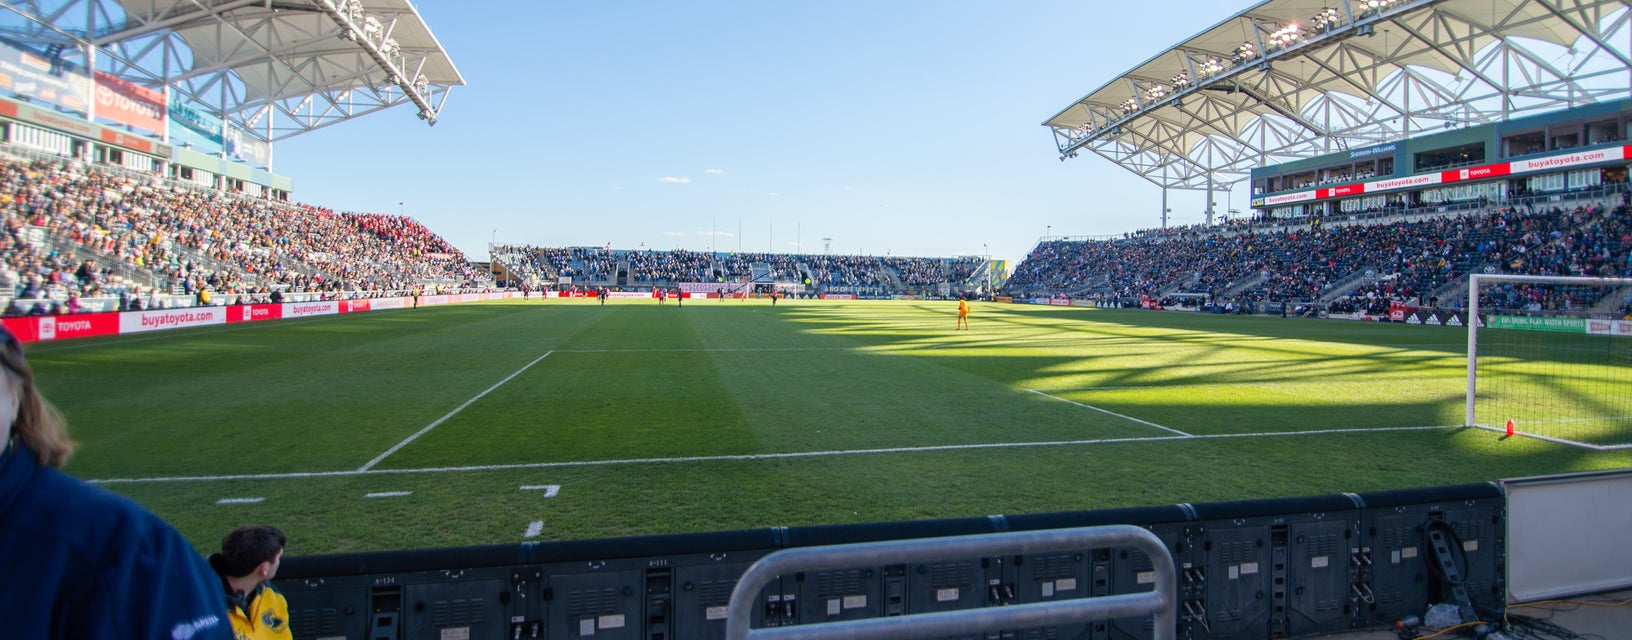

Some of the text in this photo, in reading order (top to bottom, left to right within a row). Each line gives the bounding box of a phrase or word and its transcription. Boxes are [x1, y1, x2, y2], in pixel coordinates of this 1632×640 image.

[114, 93, 162, 120] TOYOTA
[1528, 152, 1605, 169] buyatoyota.com
[1469, 168, 1491, 176] TOYOTA
[1376, 176, 1429, 189] buyatoyota.com
[1269, 193, 1307, 204] buyatoyota.com
[252, 307, 269, 316] TOYOTA
[293, 303, 332, 317] buyatoyota.com
[141, 310, 214, 327] buyatoyota.com
[57, 319, 92, 332] TOYOTA
